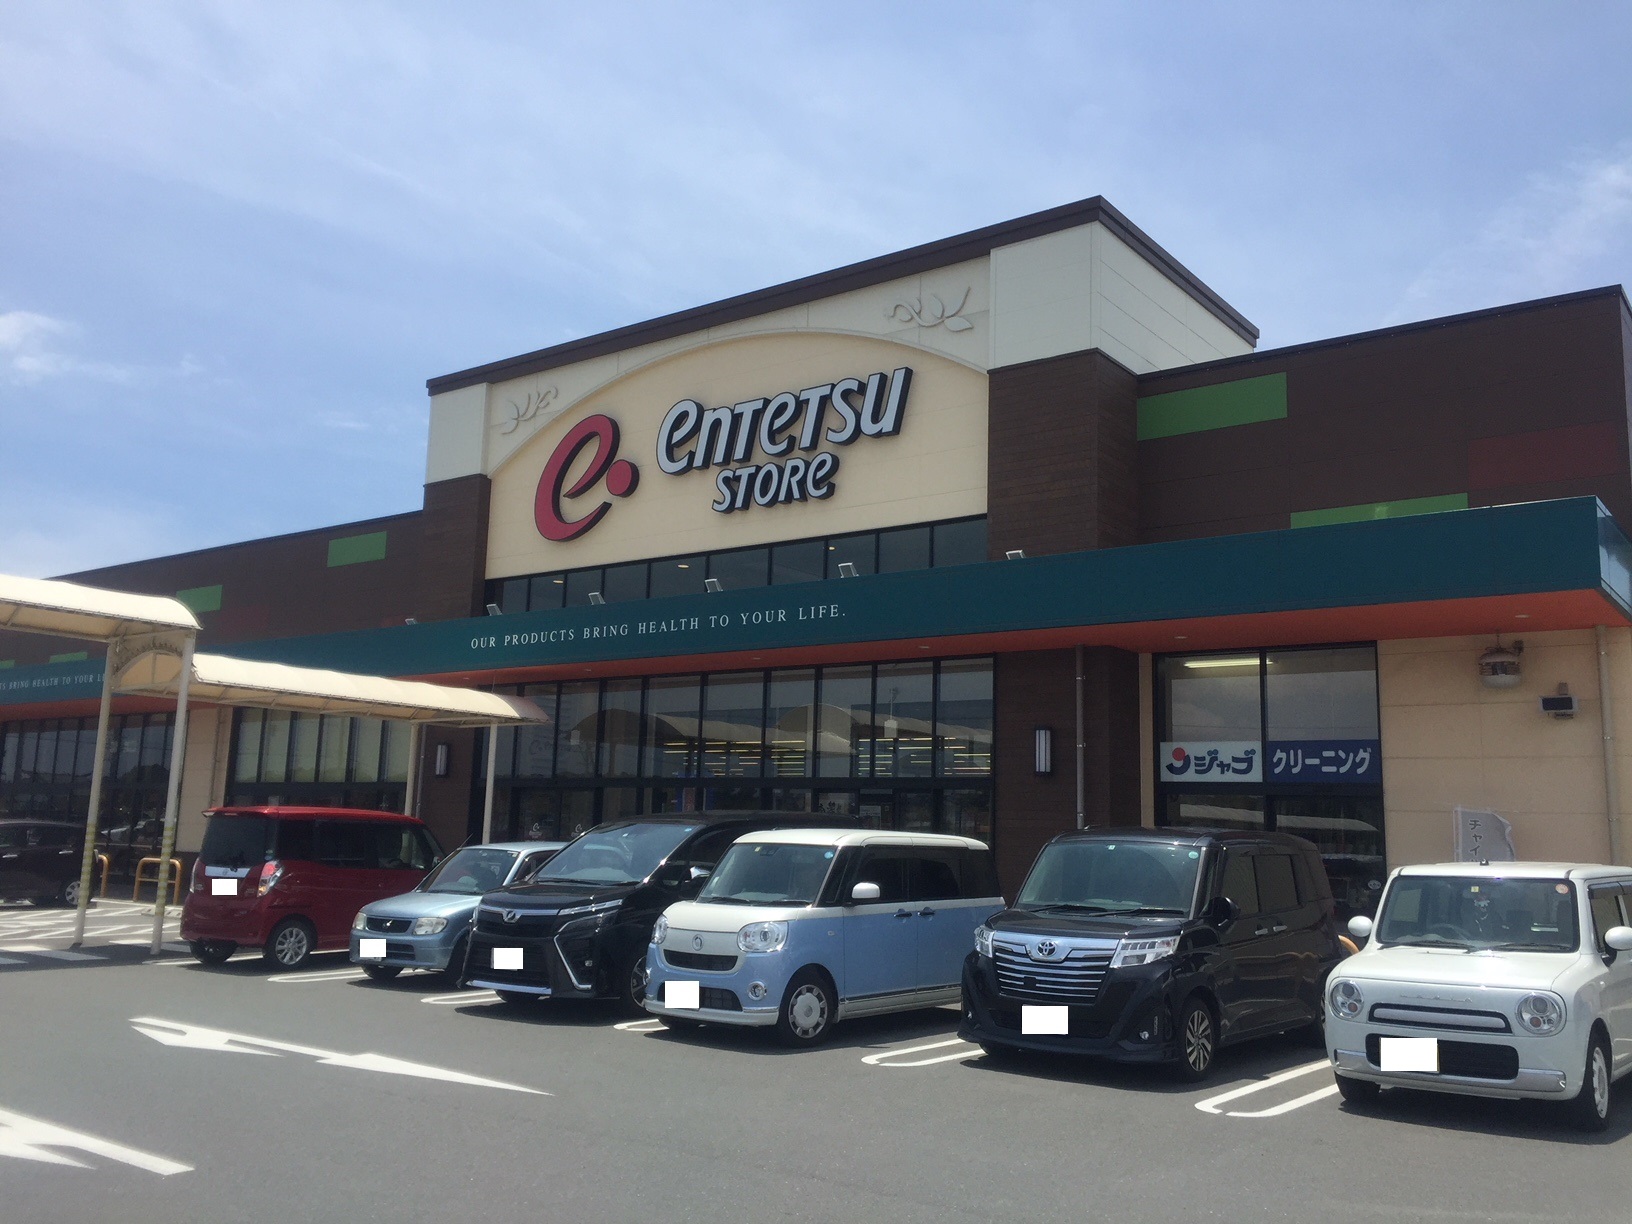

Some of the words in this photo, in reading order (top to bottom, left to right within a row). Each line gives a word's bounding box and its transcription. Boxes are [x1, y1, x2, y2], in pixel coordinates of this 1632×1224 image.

[470, 636, 496, 649] OUR
[504, 629, 575, 646] PRODUCTS
[583, 624, 629, 639] BRING
[638, 617, 699, 634] HEALTH
[709, 614, 729, 628] TO
[740, 609, 787, 625] YOUR
[799, 604, 846, 620] LIFE.
[62, 676, 71, 685] TO
[74, 674, 94, 684] YOUR
[1272, 747, 1372, 775] クリーニング
[1468, 819, 1483, 862] チャイ
